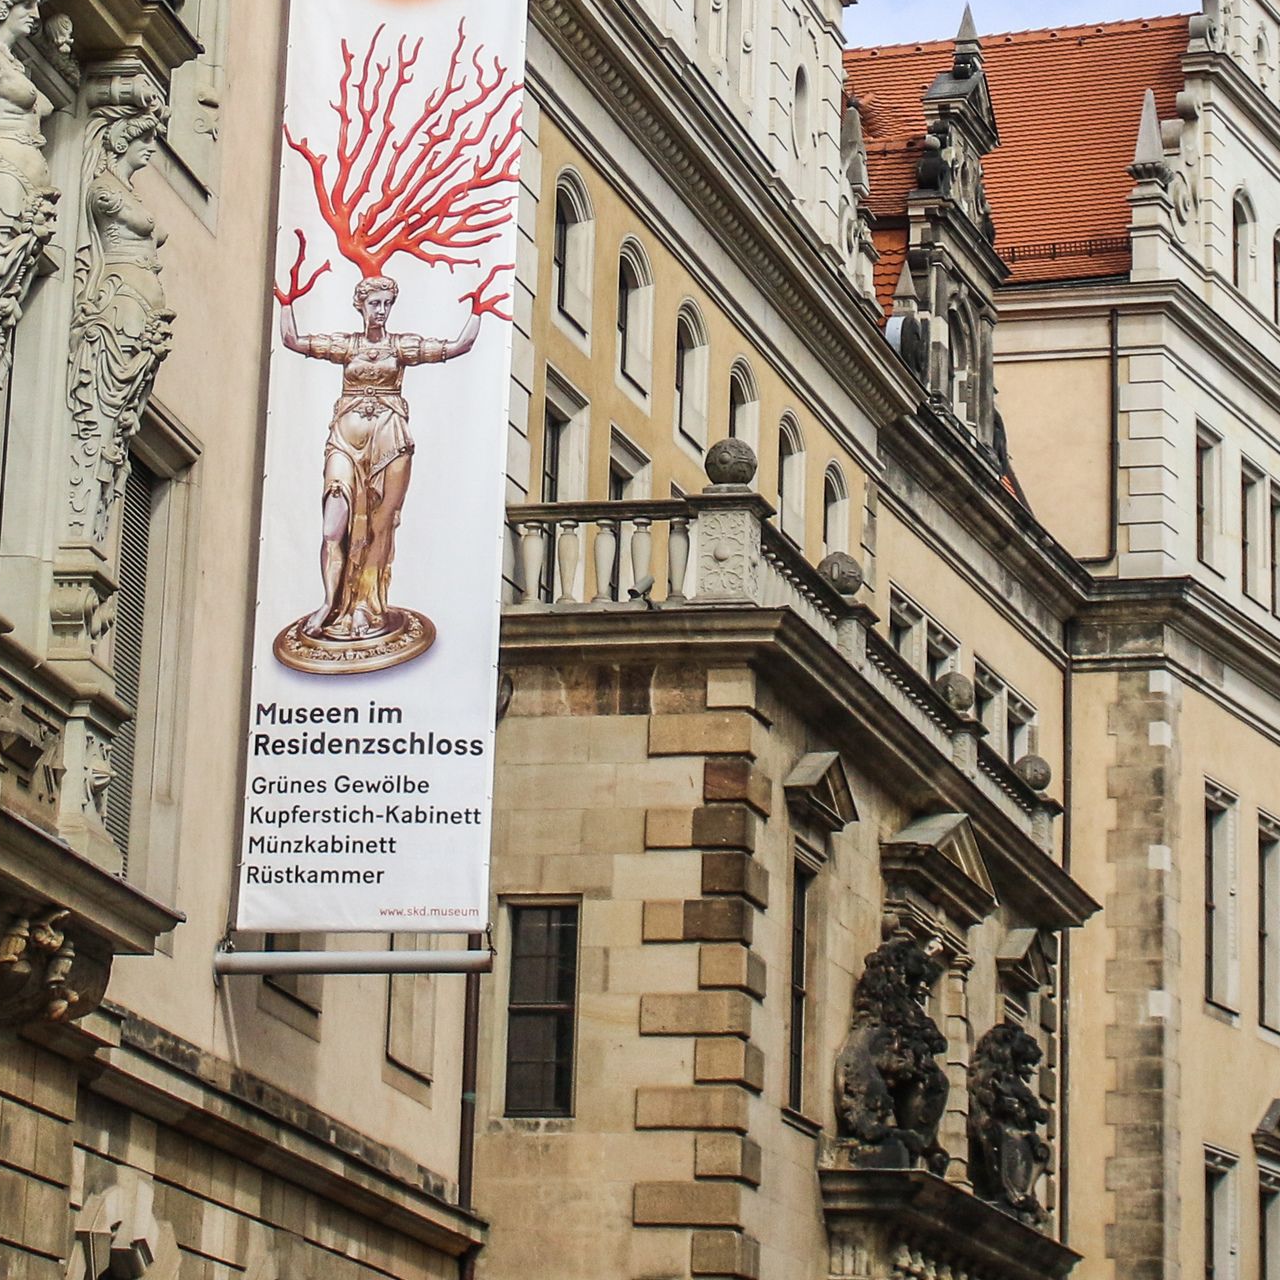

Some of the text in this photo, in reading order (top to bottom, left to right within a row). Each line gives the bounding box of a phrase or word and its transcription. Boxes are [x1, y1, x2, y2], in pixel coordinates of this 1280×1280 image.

[255, 700, 403, 726] Museen im
[253, 731, 484, 757] Residenzschloss
[251, 774, 430, 795] Grünes Gewölbe
[250, 804, 482, 829] Kupferstich-Kabinett
[248, 834, 397, 855] Münzkabinett
[246, 864, 385, 885] Rüstkammer
[379, 906, 480, 917] www.skd.museum
